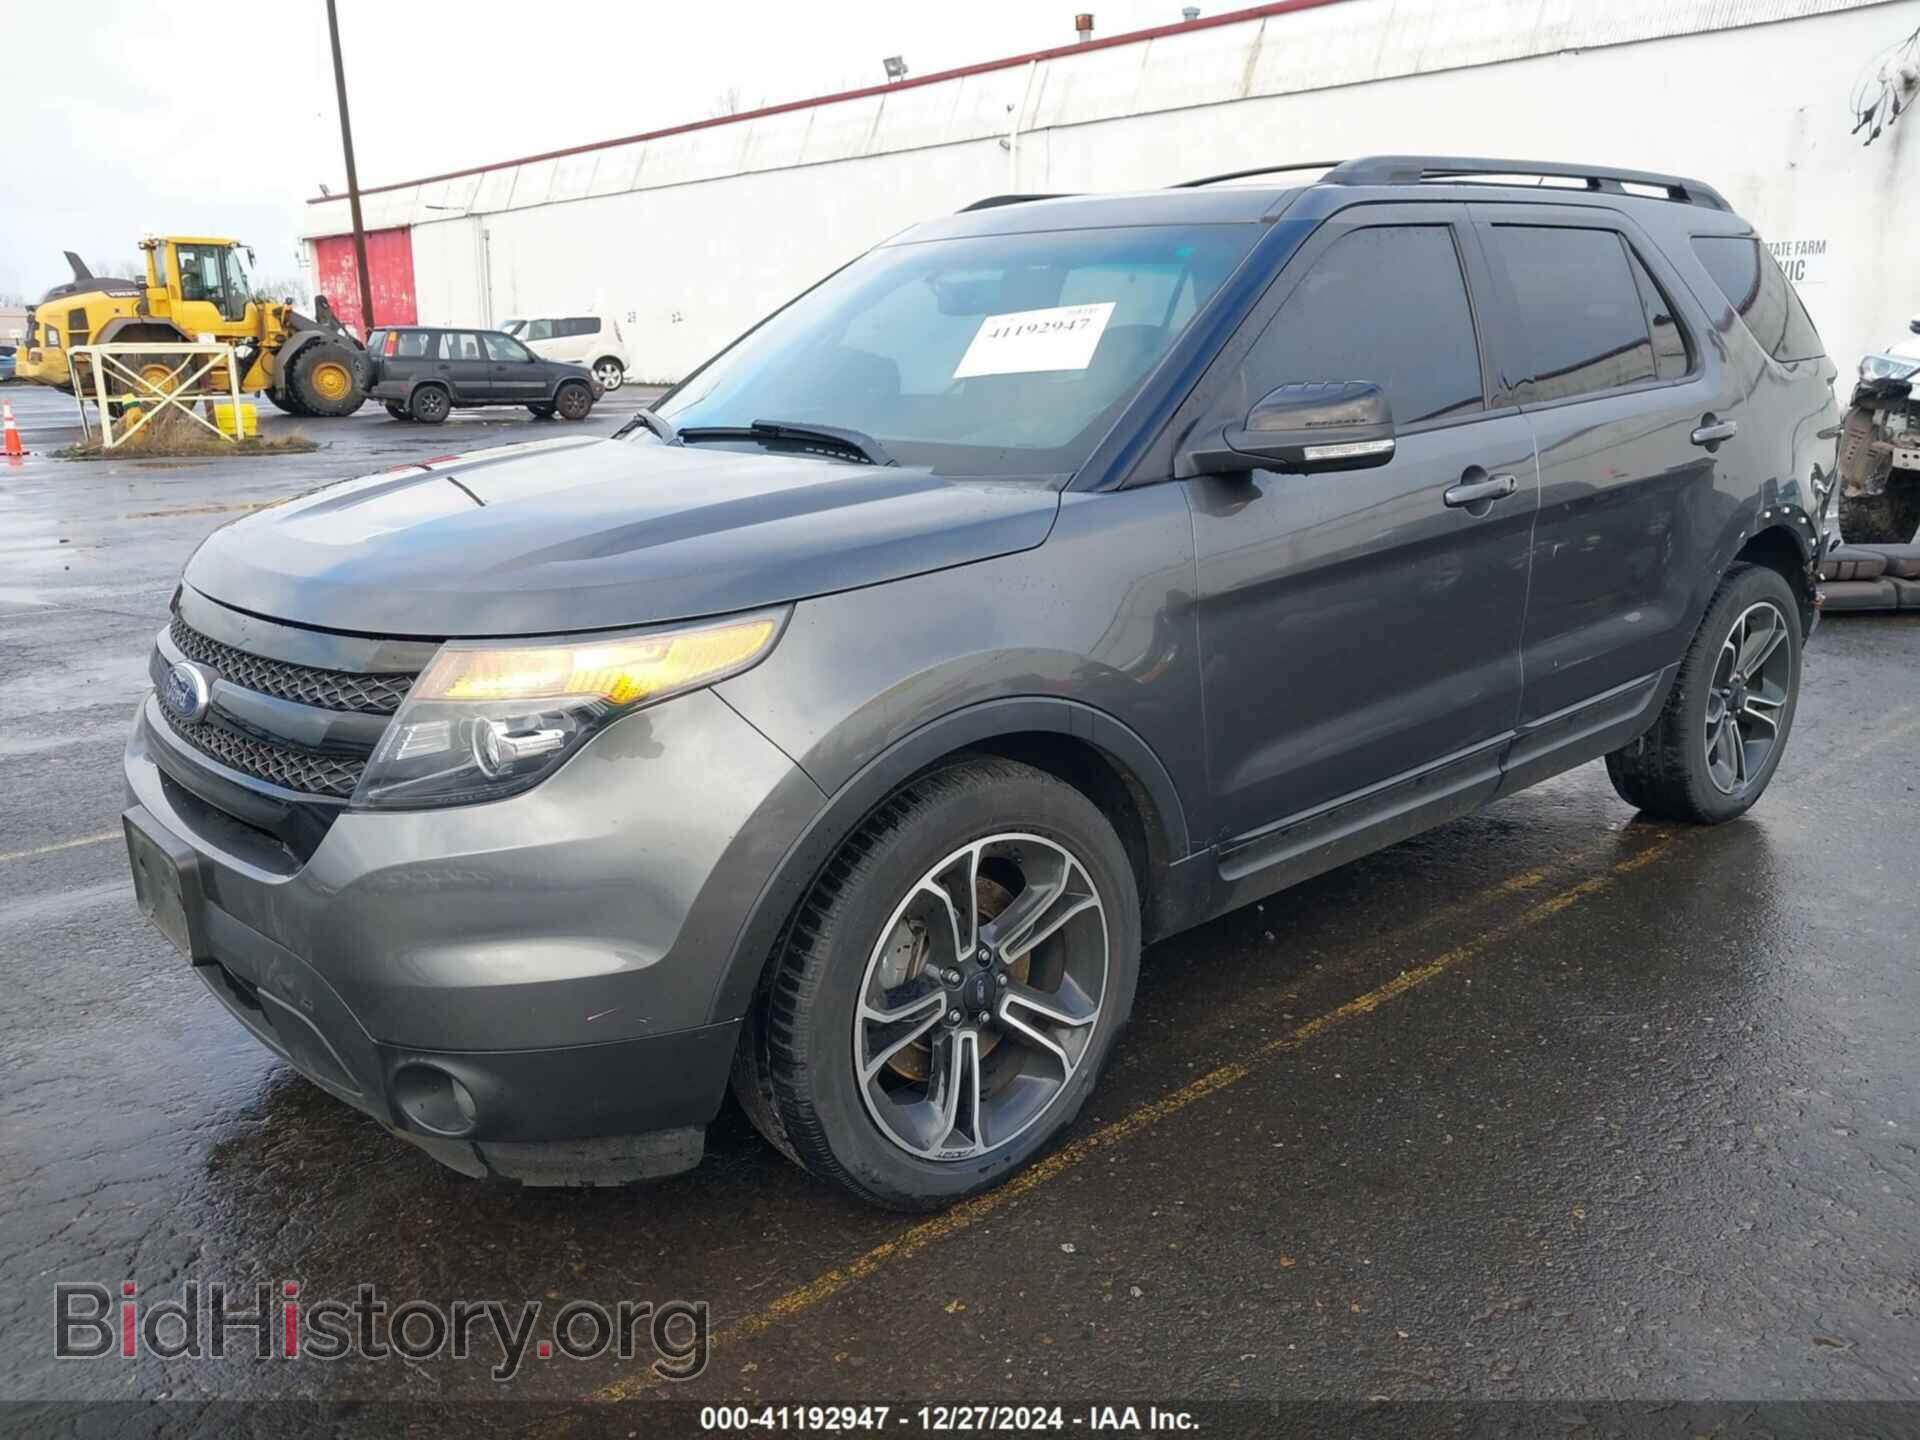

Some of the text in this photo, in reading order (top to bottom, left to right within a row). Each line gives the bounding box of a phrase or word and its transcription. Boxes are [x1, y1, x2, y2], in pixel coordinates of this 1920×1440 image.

[1765, 239, 1826, 256] TATE FARM
[988, 317, 1091, 339] 41192947
